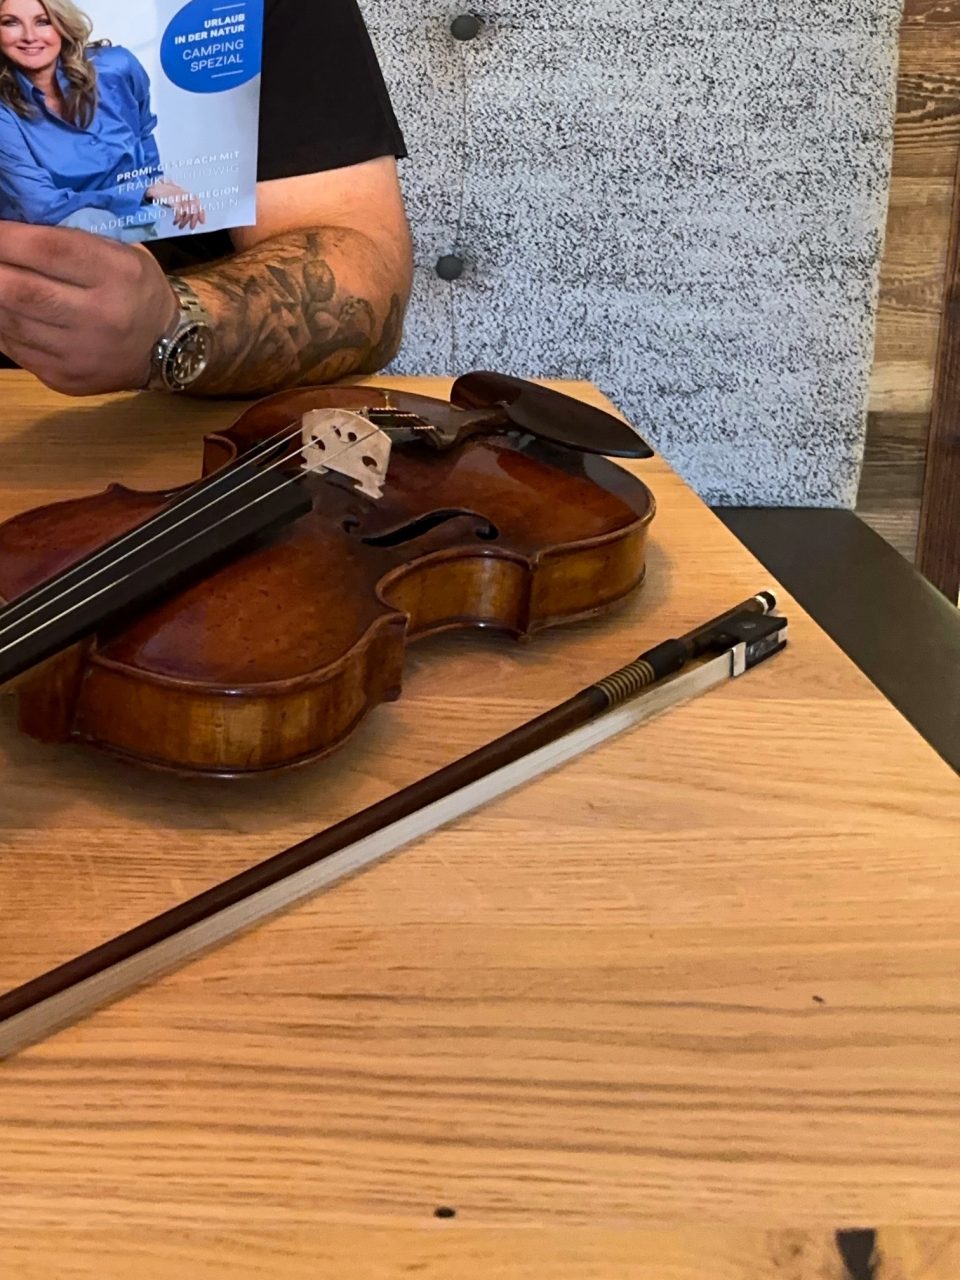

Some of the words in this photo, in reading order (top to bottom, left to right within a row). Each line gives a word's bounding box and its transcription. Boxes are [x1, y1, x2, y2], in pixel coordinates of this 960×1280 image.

[204, 13, 246, 29] URLAUB
[174, 35, 187, 45] IN
[188, 31, 208, 42] DER
[210, 24, 245, 38] NATUR
[182, 38, 244, 61] CAMPING
[190, 53, 244, 73] SPEZIAL
